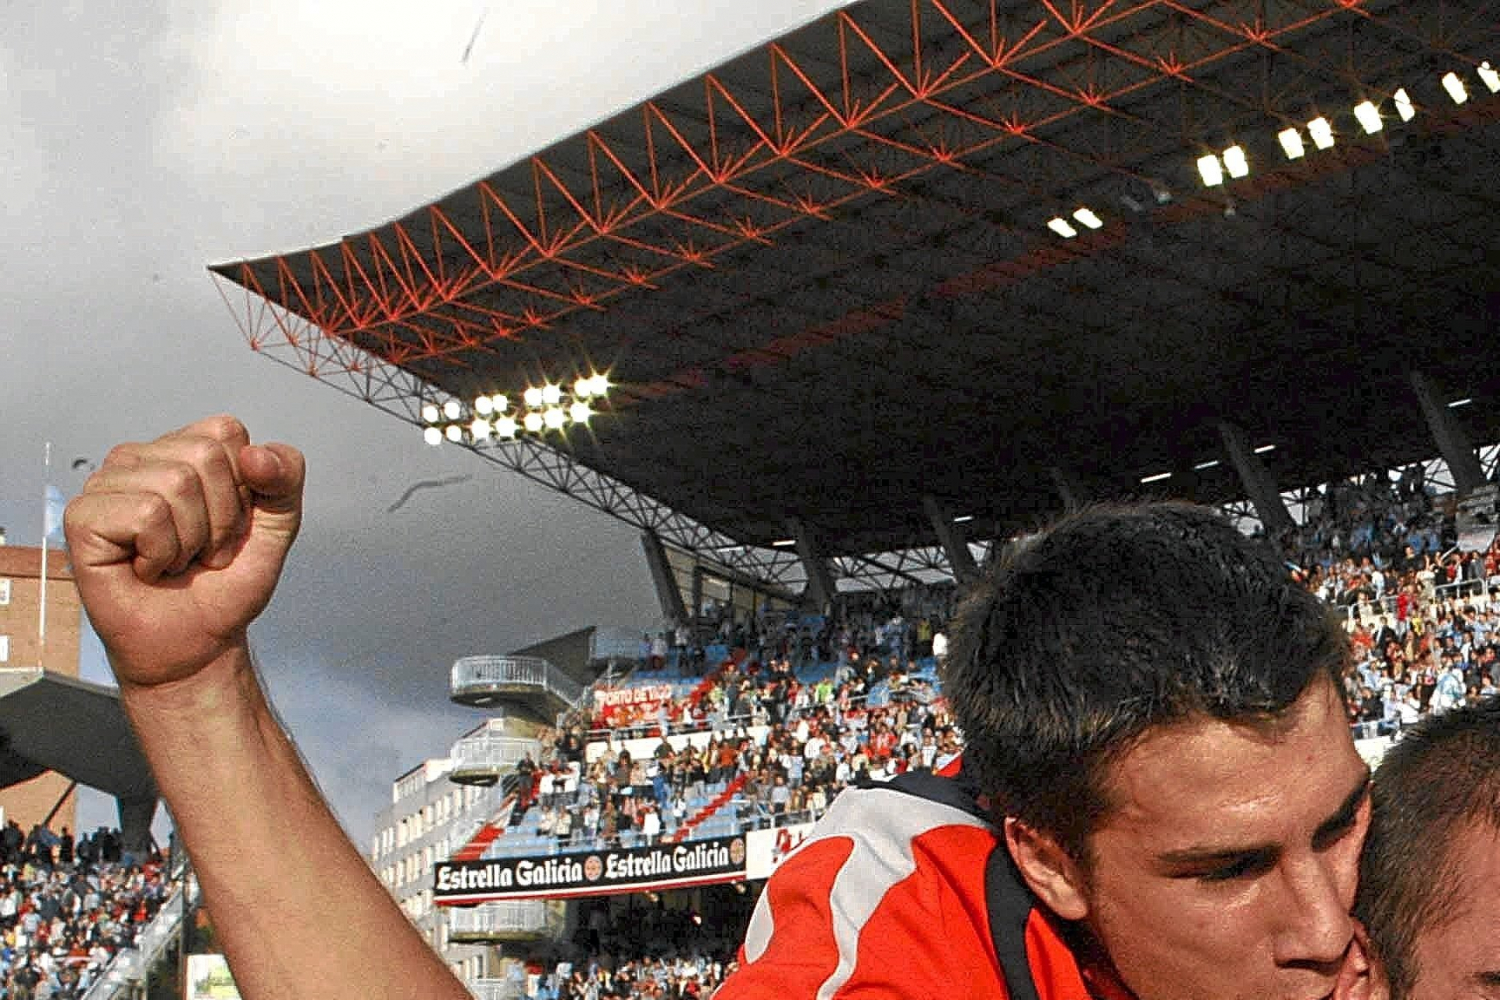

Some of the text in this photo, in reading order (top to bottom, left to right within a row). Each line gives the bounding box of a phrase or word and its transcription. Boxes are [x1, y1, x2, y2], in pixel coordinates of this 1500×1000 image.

[438, 860, 583, 891] Estrella Galicia
[605, 842, 730, 878] Estrella Galicia
